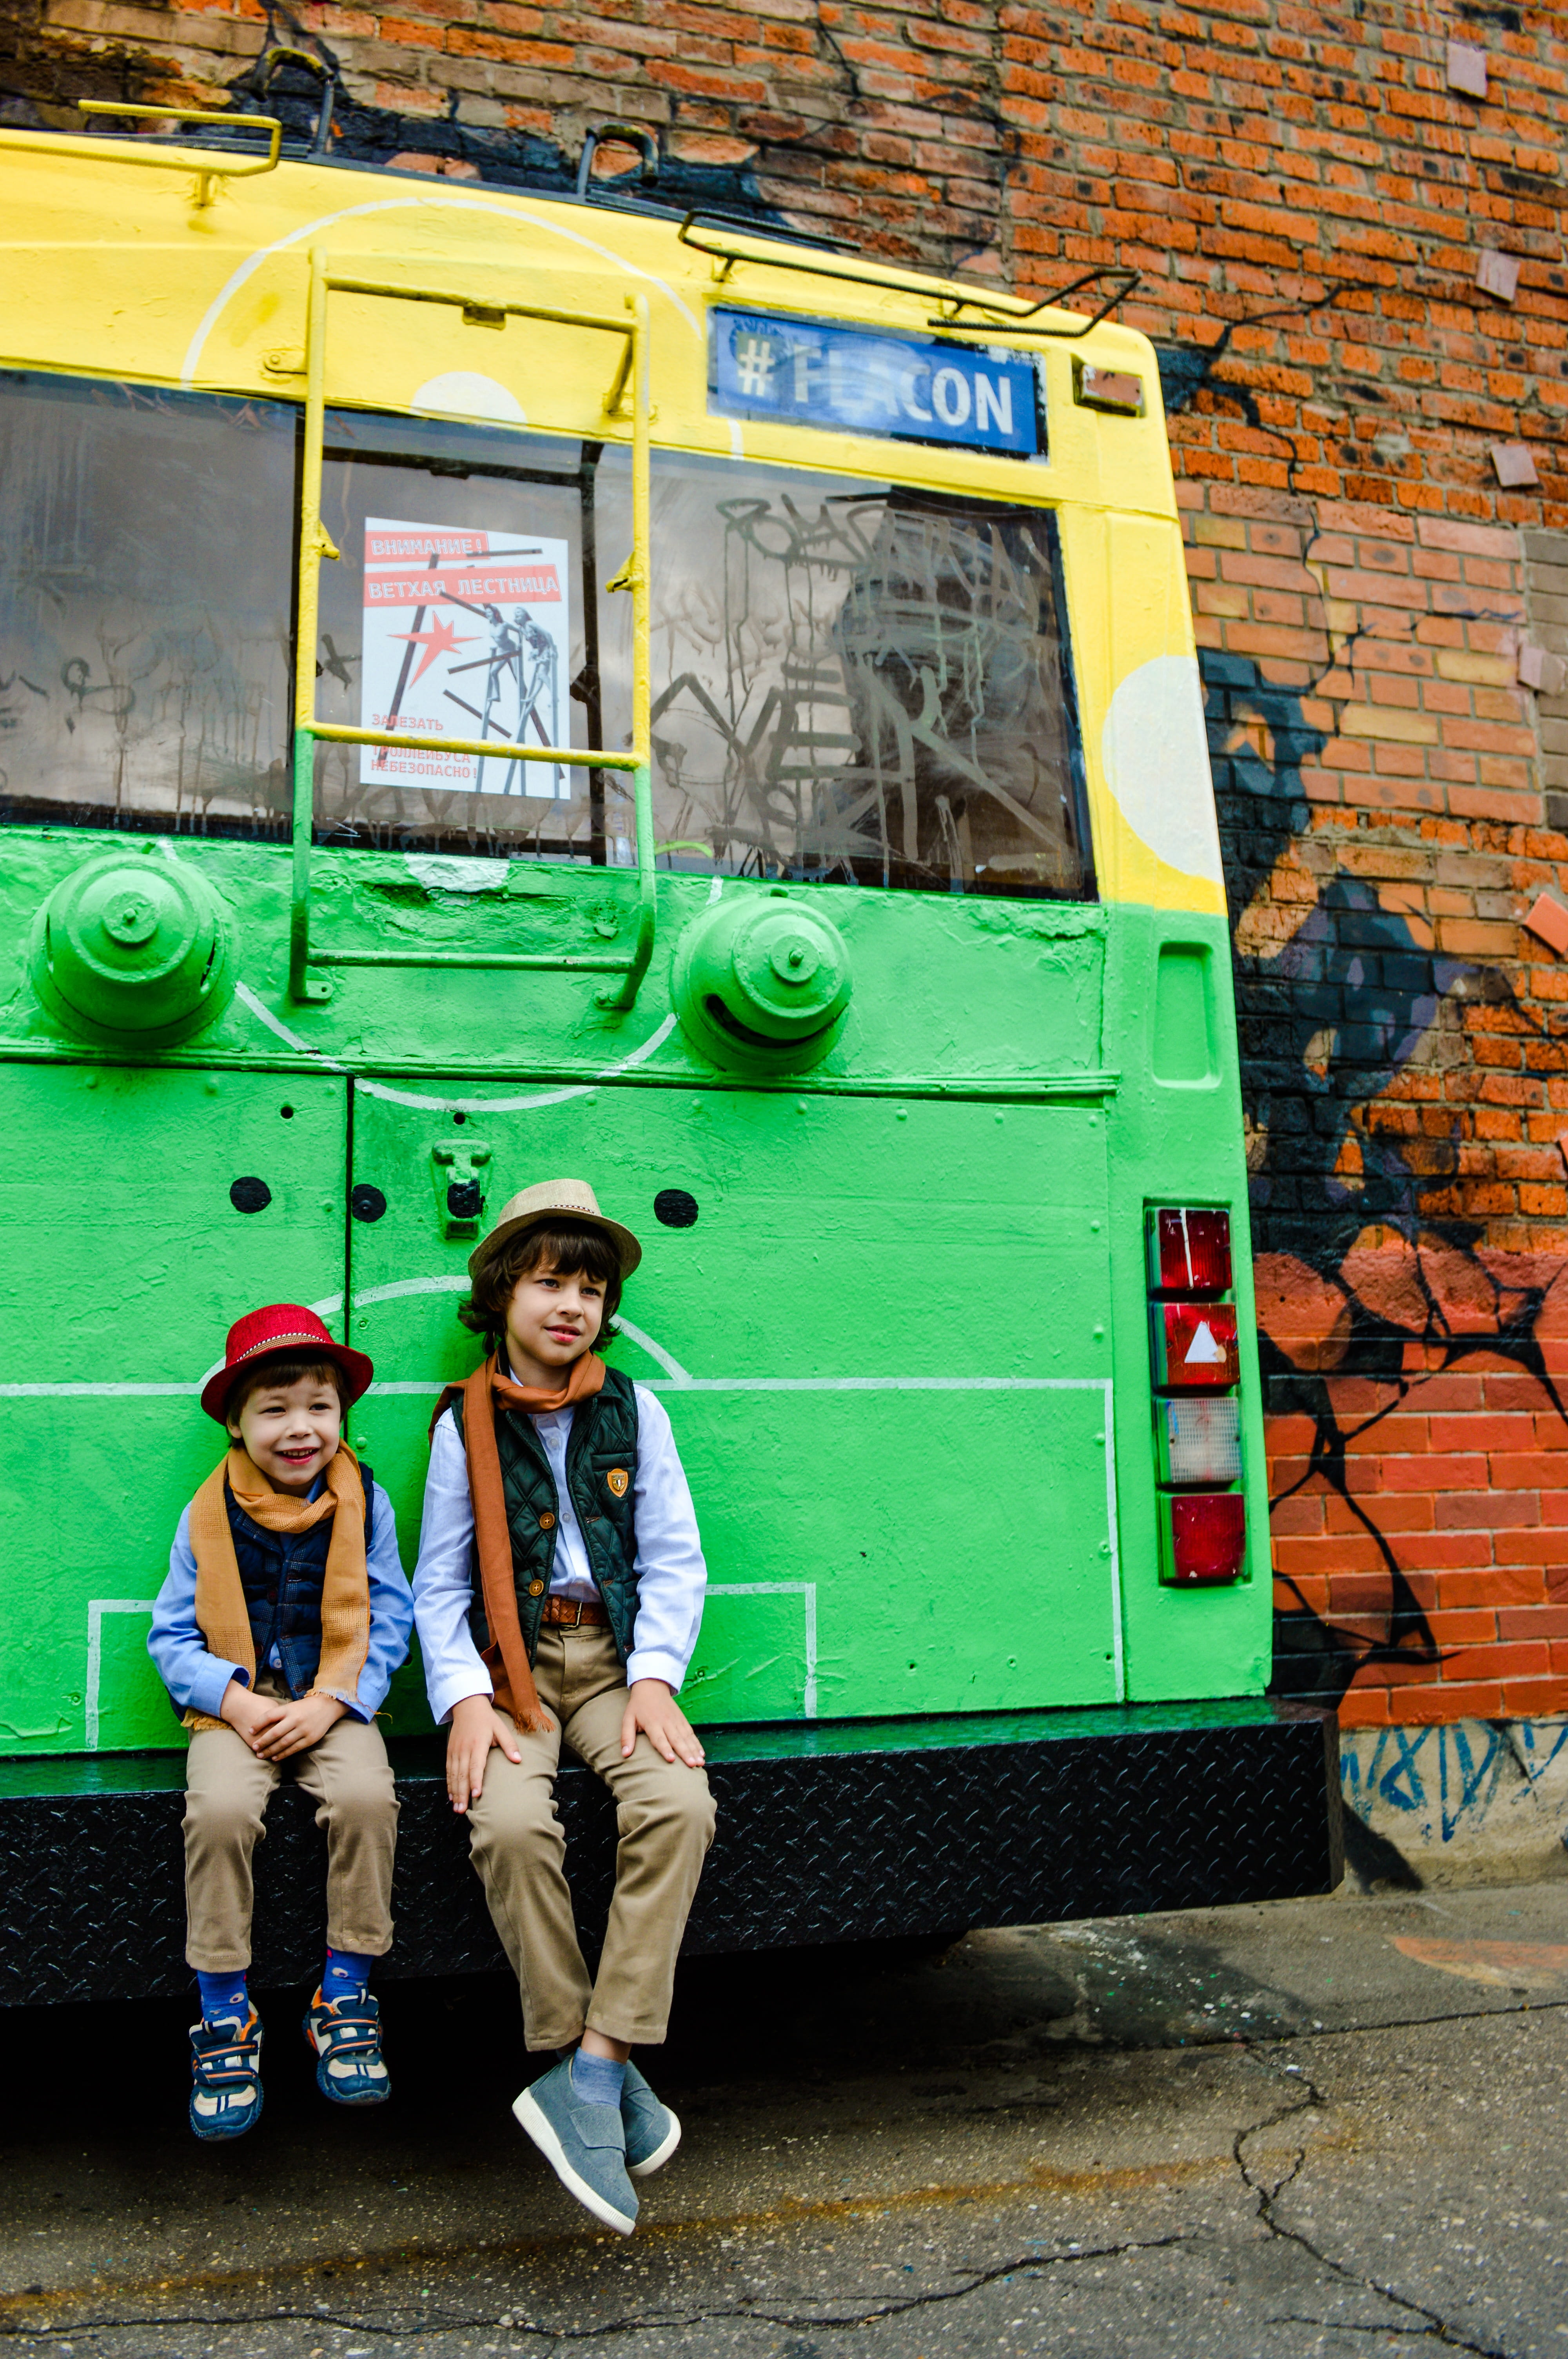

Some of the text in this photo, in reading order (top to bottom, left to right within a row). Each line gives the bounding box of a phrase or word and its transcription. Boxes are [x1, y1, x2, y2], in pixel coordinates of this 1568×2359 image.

[372, 539, 482, 554] ВНИМАНИЕ!
[368, 576, 559, 598] ВЕТХАЯ ЛЕСТНИЦА
[372, 714, 444, 731] ЗАЛЕЗАТЬ
